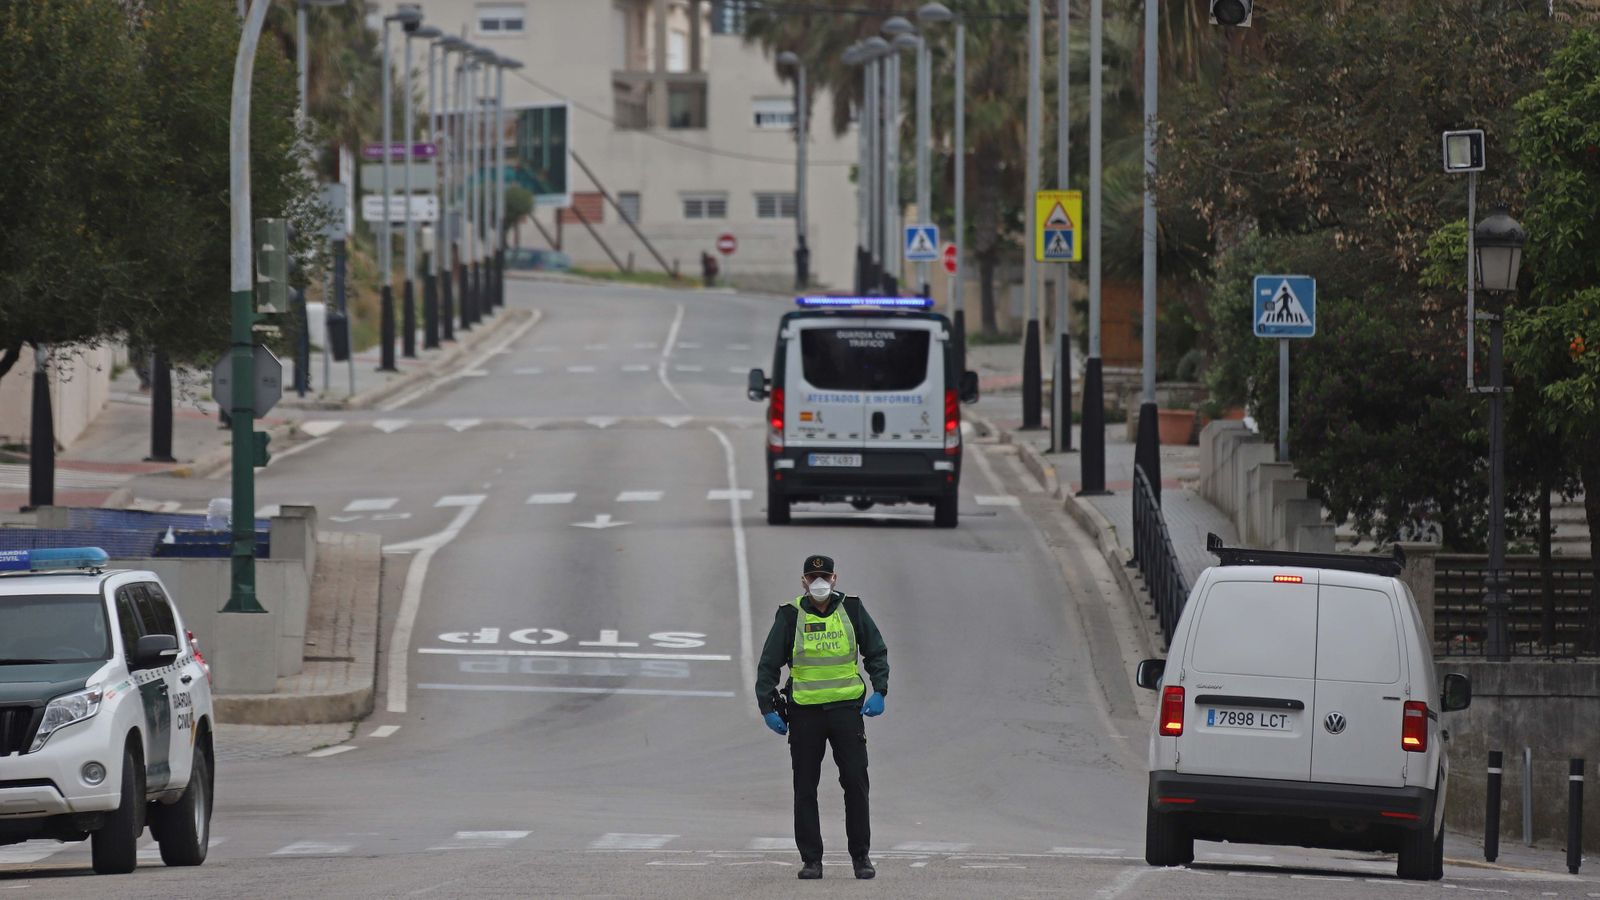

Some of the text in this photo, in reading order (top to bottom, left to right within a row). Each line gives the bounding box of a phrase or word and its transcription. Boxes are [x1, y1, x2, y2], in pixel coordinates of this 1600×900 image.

[836, 330, 896, 340] GUARDIA CIVIL
[807, 394, 923, 404] ATESTADOS E INFORMES
[438, 627, 707, 649] STOP
[807, 630, 844, 642] GUARDIA
[815, 641, 841, 651] CIVIL
[1219, 711, 1288, 728] 7898 LCT
